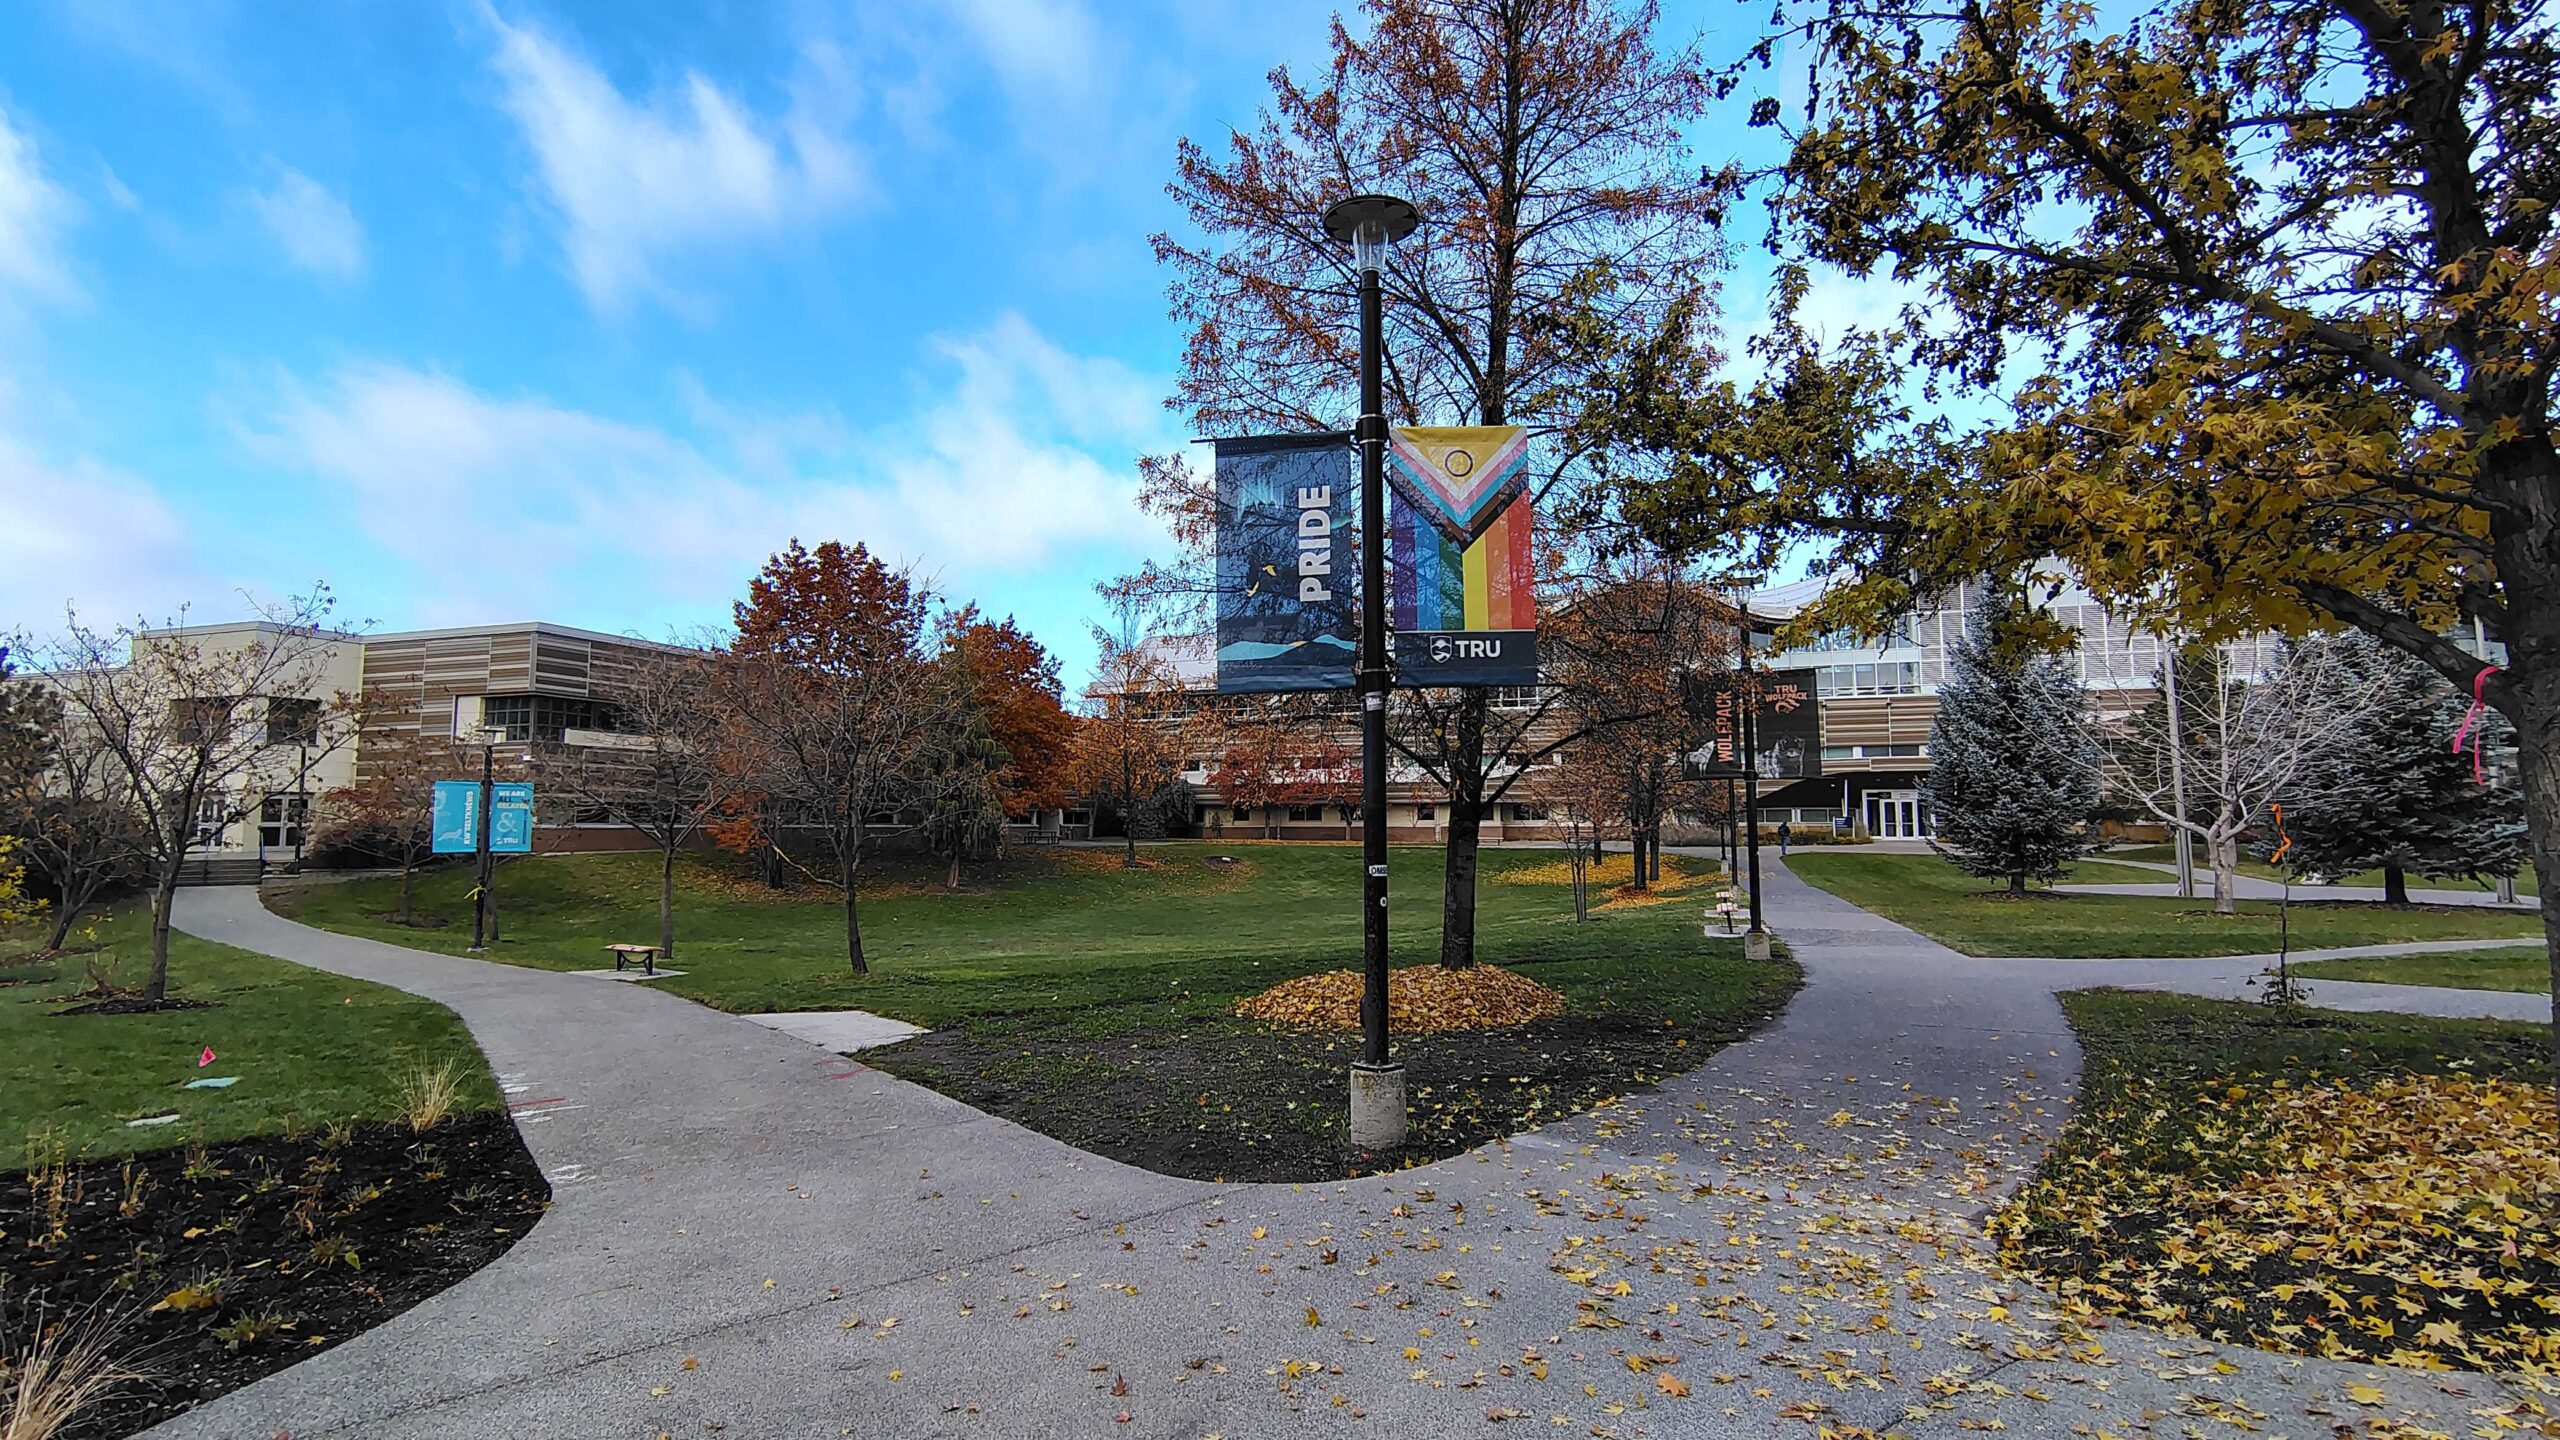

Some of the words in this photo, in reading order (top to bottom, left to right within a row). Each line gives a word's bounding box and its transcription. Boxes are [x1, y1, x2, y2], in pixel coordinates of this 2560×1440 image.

[1298, 485, 1332, 602] PRIDE
[1454, 640, 1501, 658] TRU
[1764, 692, 1808, 703] WOLFPACK
[1773, 684, 1798, 693] TRU
[1715, 690, 1734, 763] WOLFPACK
